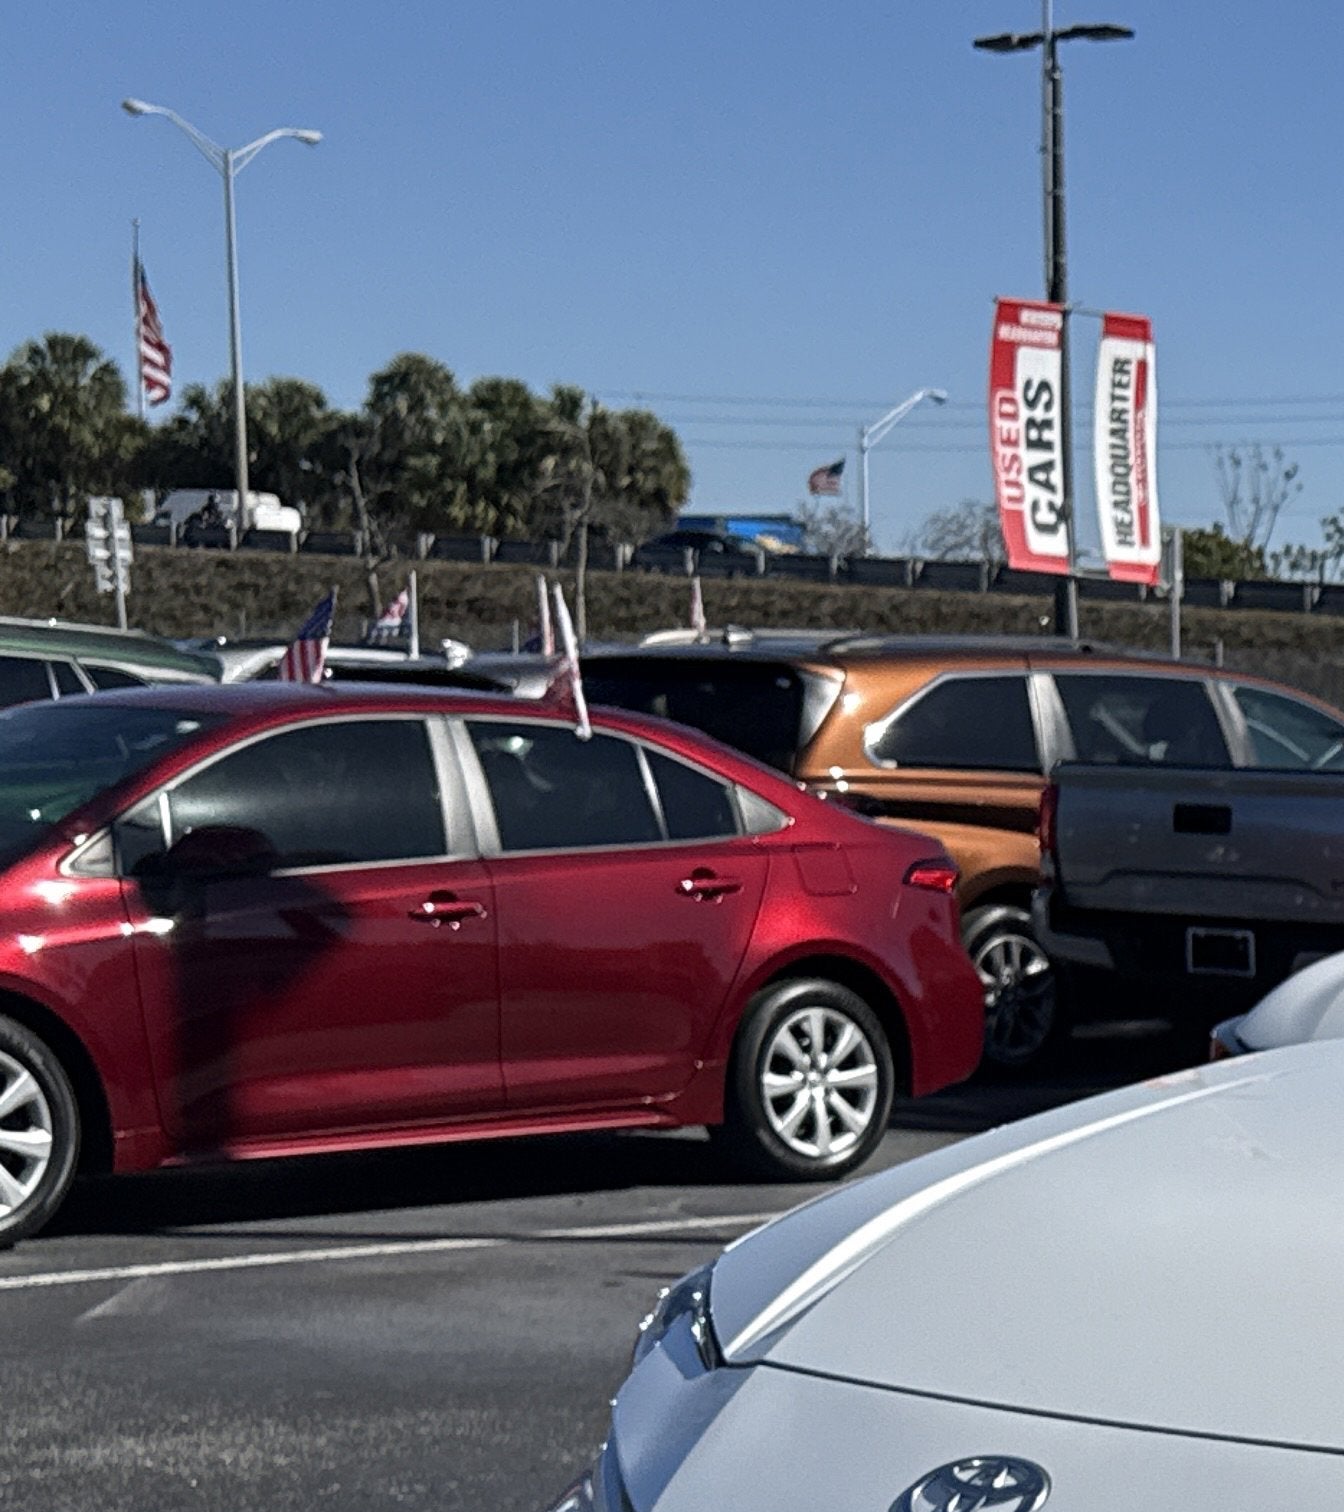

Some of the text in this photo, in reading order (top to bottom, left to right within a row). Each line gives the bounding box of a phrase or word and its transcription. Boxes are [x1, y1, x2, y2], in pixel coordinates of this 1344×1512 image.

[998, 396, 1024, 504] USED
[1023, 378, 1059, 535] CARS
[1108, 357, 1134, 547] HEADQUARTER
